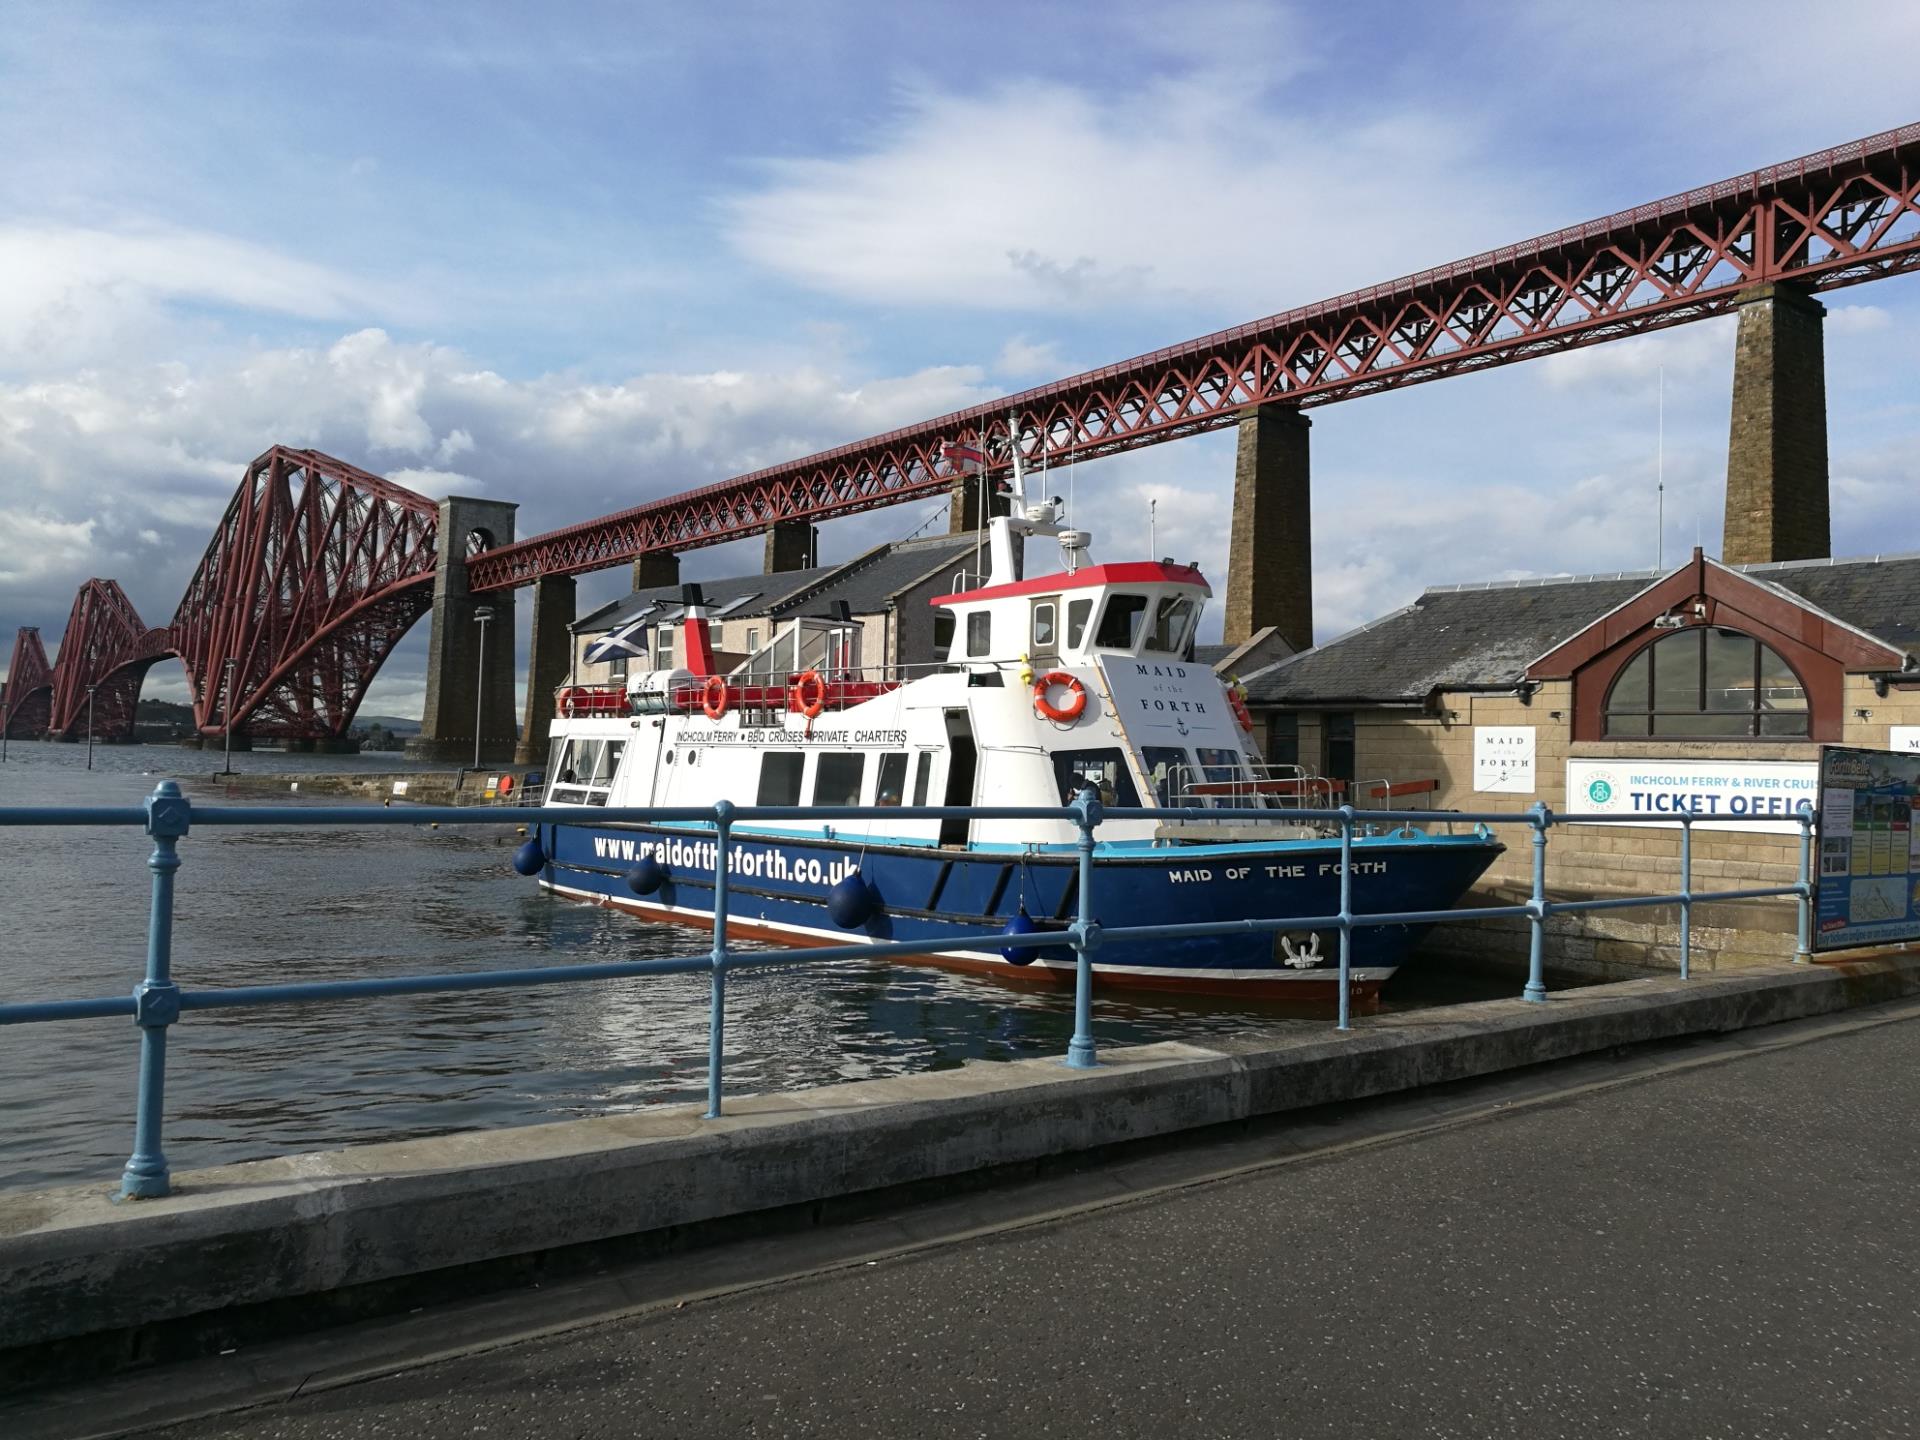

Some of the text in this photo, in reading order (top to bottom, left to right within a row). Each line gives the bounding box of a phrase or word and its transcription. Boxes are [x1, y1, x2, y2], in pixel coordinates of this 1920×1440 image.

[1136, 664, 1186, 678] MAID
[1141, 699, 1206, 714] FORTH
[713, 731, 738, 743] FERRY
[747, 730, 765, 743] BBQ
[768, 730, 804, 743] CRUISES
[812, 730, 848, 743] PRIVATE
[854, 730, 907, 743] CHARTERS
[1486, 737, 1524, 745] MAID
[1480, 759, 1529, 767] FORTH
[1630, 775, 1689, 787] INCHCOLM
[1692, 776, 1730, 787] FERRY
[1732, 777, 1741, 787] &
[1744, 777, 1780, 789] RIVER
[1630, 792, 1721, 814] TICKET
[1169, 869, 1213, 883] MAID
[1225, 868, 1251, 880] OF
[1264, 865, 1306, 878] THE
